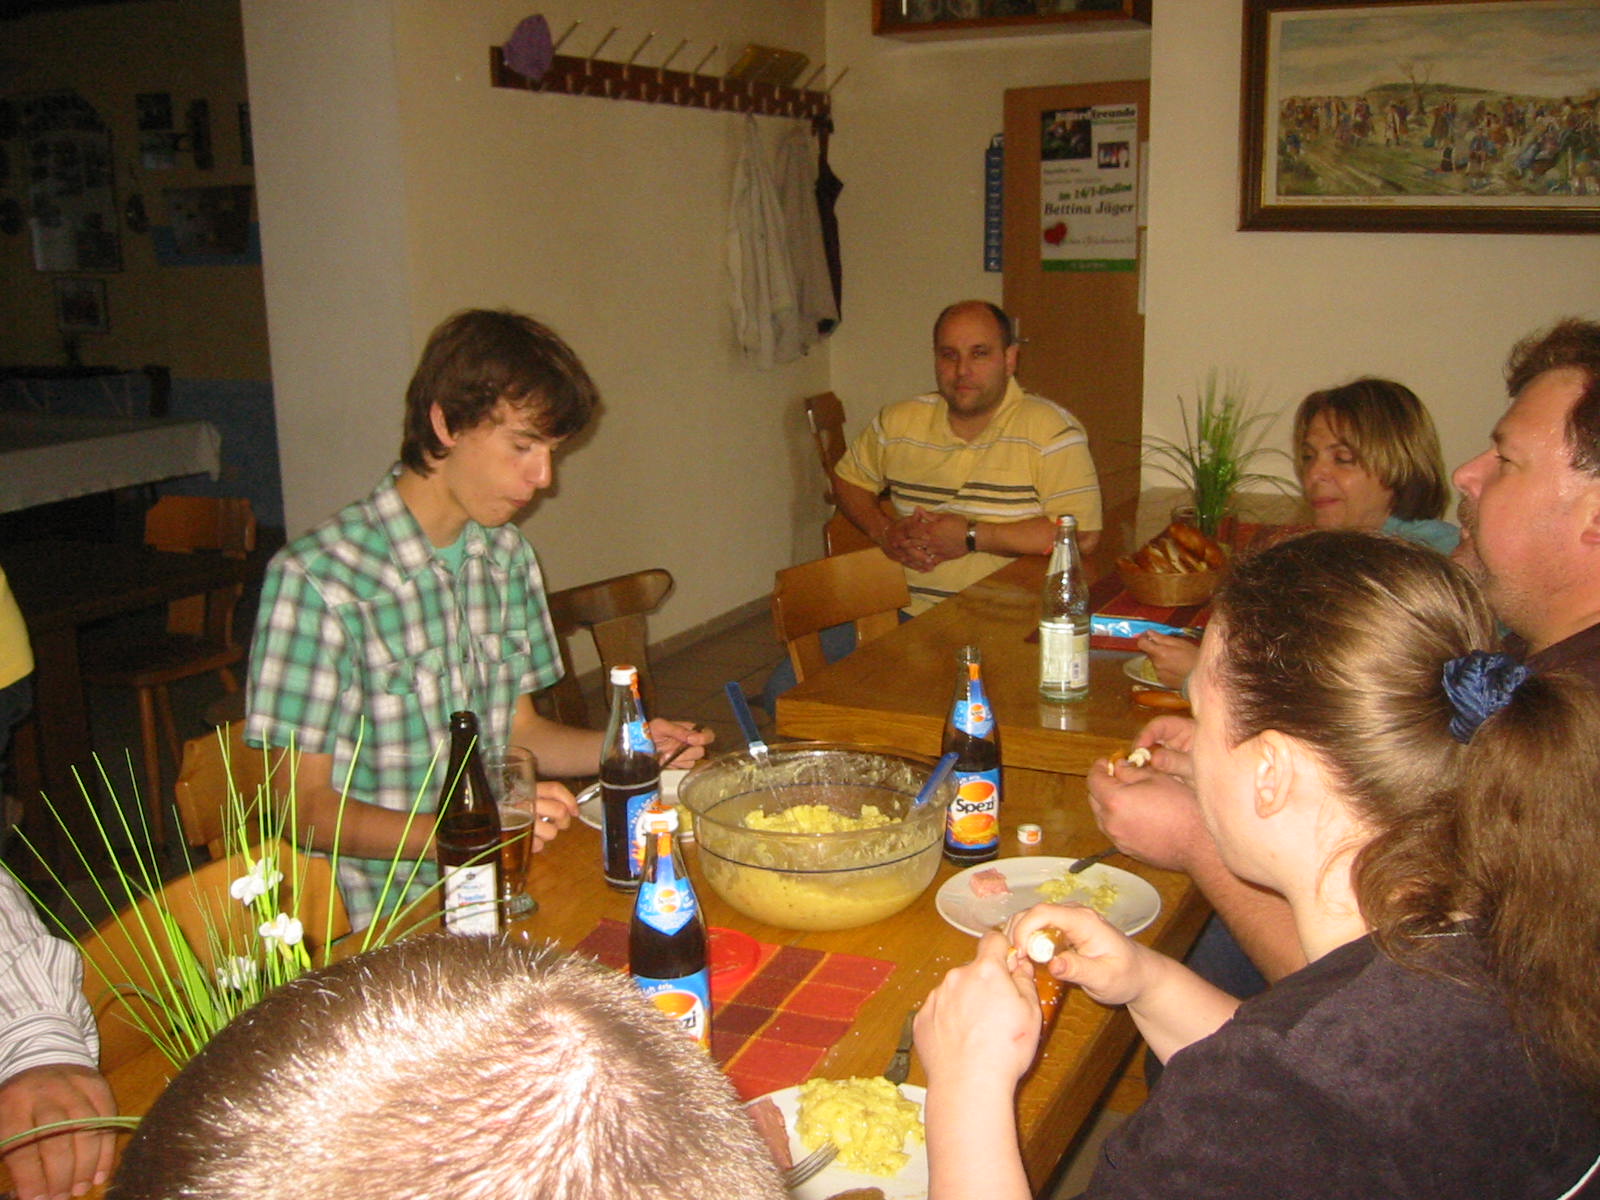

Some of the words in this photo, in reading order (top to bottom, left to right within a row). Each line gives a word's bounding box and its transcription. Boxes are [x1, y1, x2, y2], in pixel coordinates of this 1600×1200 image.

[1045, 202, 1091, 215] Bettina
[1095, 201, 1134, 216] Jäger
[956, 796, 995, 814] Spezi
